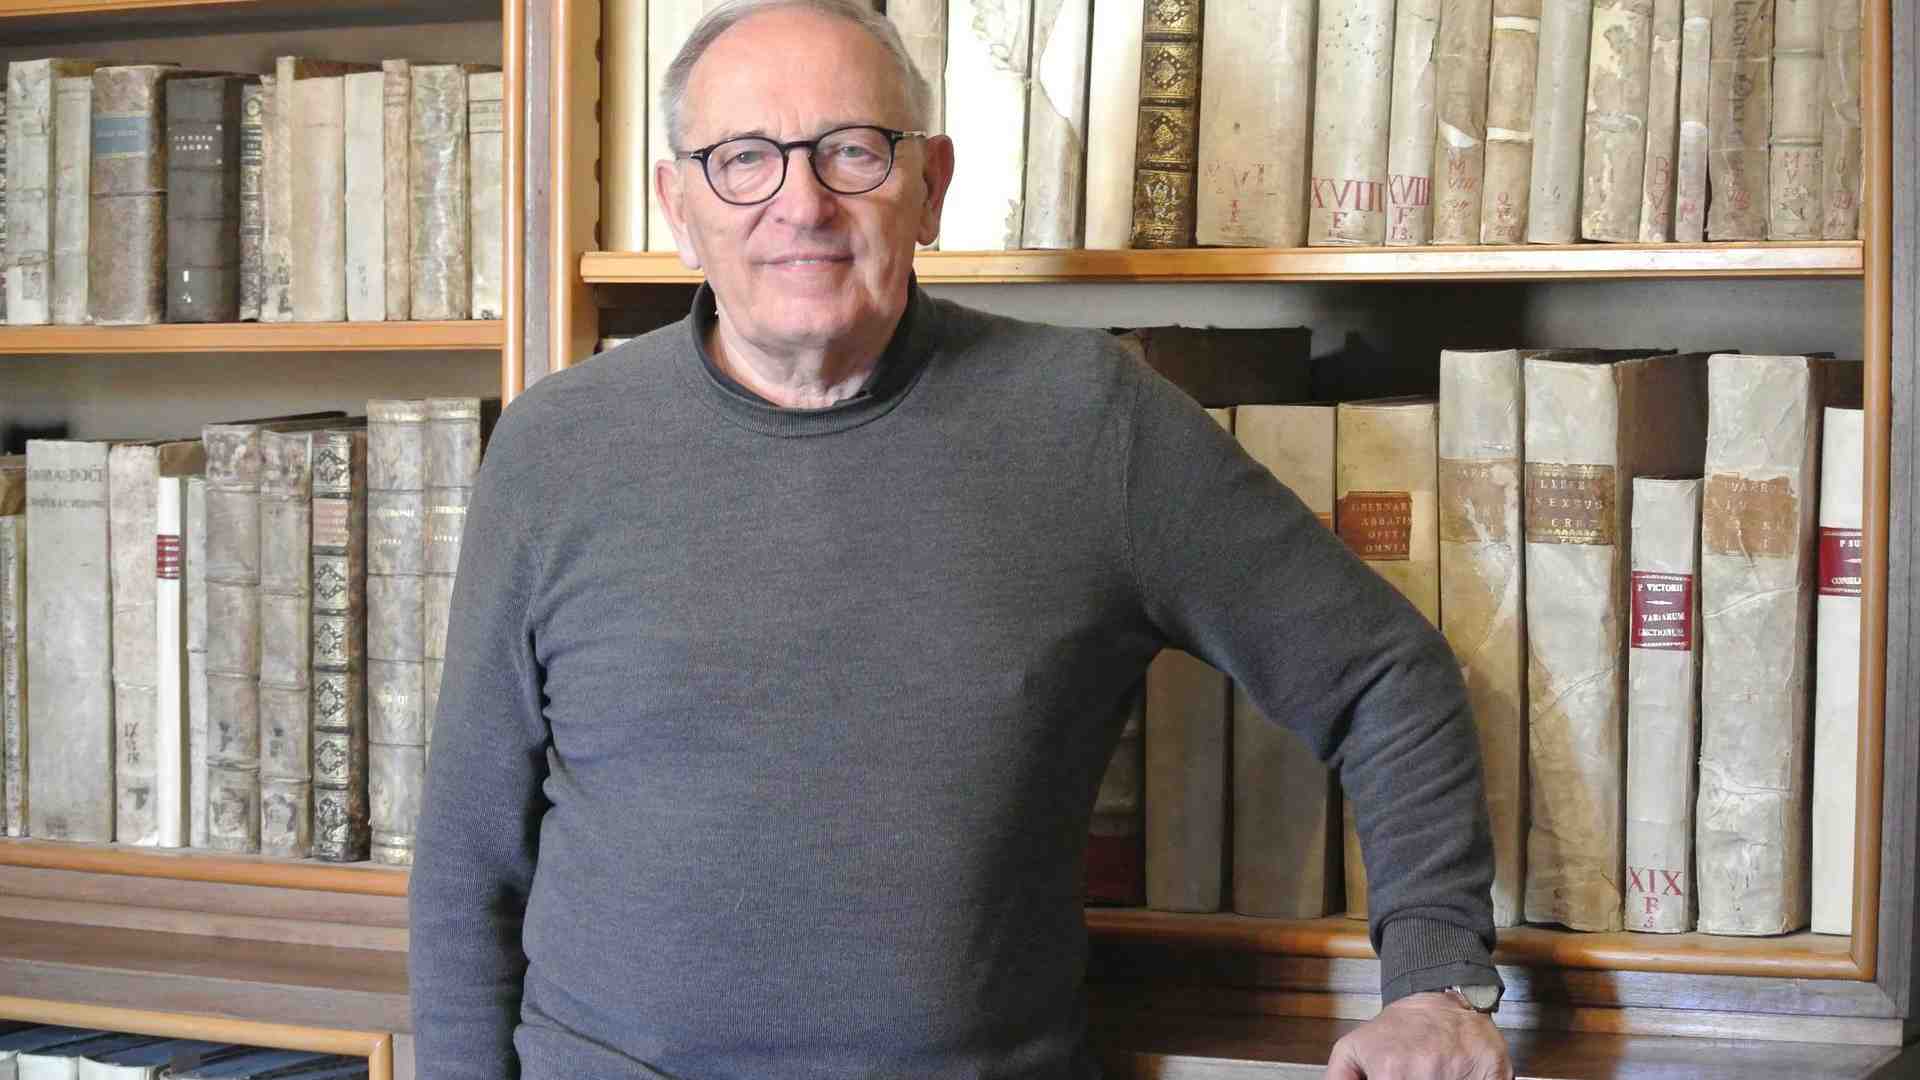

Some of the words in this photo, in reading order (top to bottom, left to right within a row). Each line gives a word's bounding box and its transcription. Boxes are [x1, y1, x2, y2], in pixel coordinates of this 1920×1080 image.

[1311, 175, 1384, 213] XVIII
[1387, 174, 1430, 208] XVIII
[1628, 864, 1683, 896] XIX
